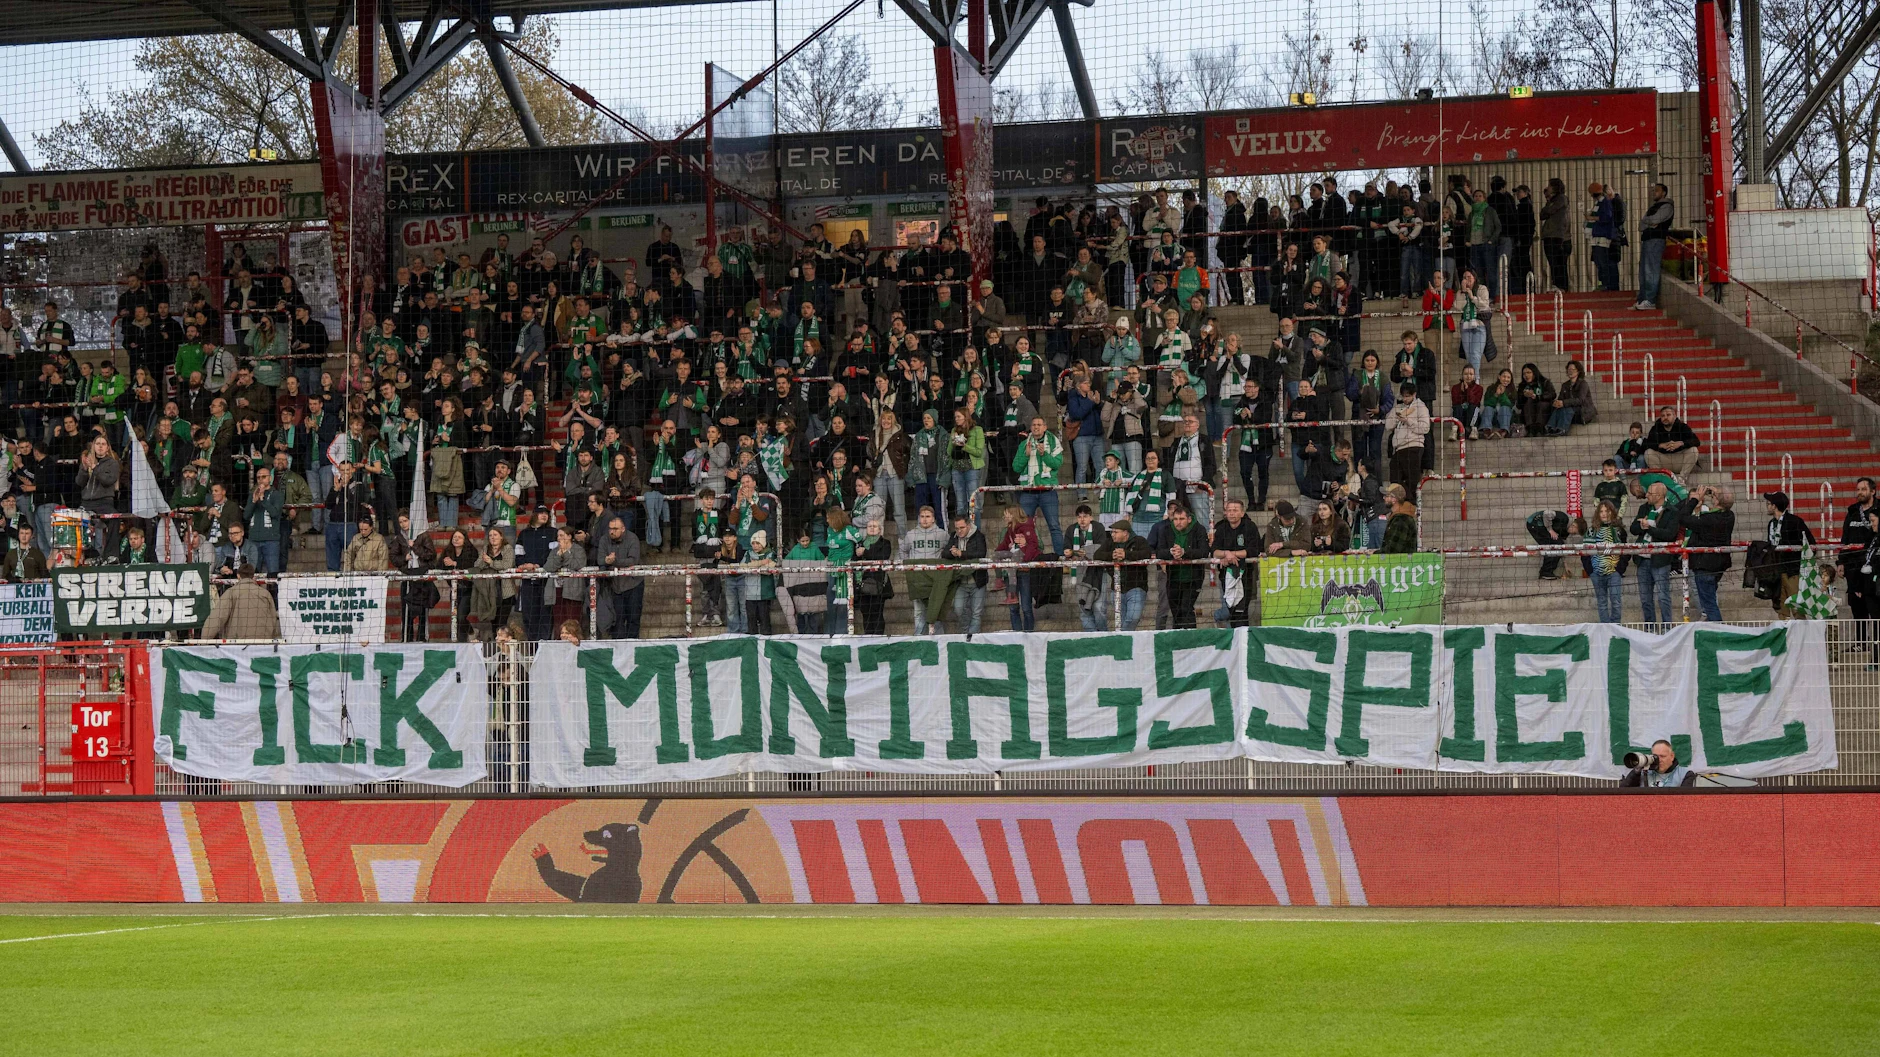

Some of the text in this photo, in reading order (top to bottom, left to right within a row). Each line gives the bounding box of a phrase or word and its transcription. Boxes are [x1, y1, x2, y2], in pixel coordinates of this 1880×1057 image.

[1377, 115, 1634, 156] Bringt Licht ins Leben
[574, 153, 636, 178] WIR
[898, 142, 945, 162] DA
[1112, 162, 1187, 176] CAPIAL
[387, 163, 455, 192] REX
[2, 190, 24, 204] DIE
[28, 180, 119, 203] FLAMME
[123, 185, 152, 198] DER
[155, 174, 235, 198] REGION
[387, 197, 455, 210] CAITAL
[1265, 559, 1441, 594] Fläminger
[15, 584, 47, 598] KEIN
[299, 587, 367, 598] SUPPORT
[67, 598, 198, 627] VERDE
[288, 599, 378, 611] YOUR LOCAL
[24, 617, 51, 631] DEM
[301, 612, 364, 623] WOMEN'S
[313, 625, 354, 634] TEAM
[80, 706, 112, 727] Tor
[160, 648, 465, 770] FICK
[84, 736, 109, 758] 13
